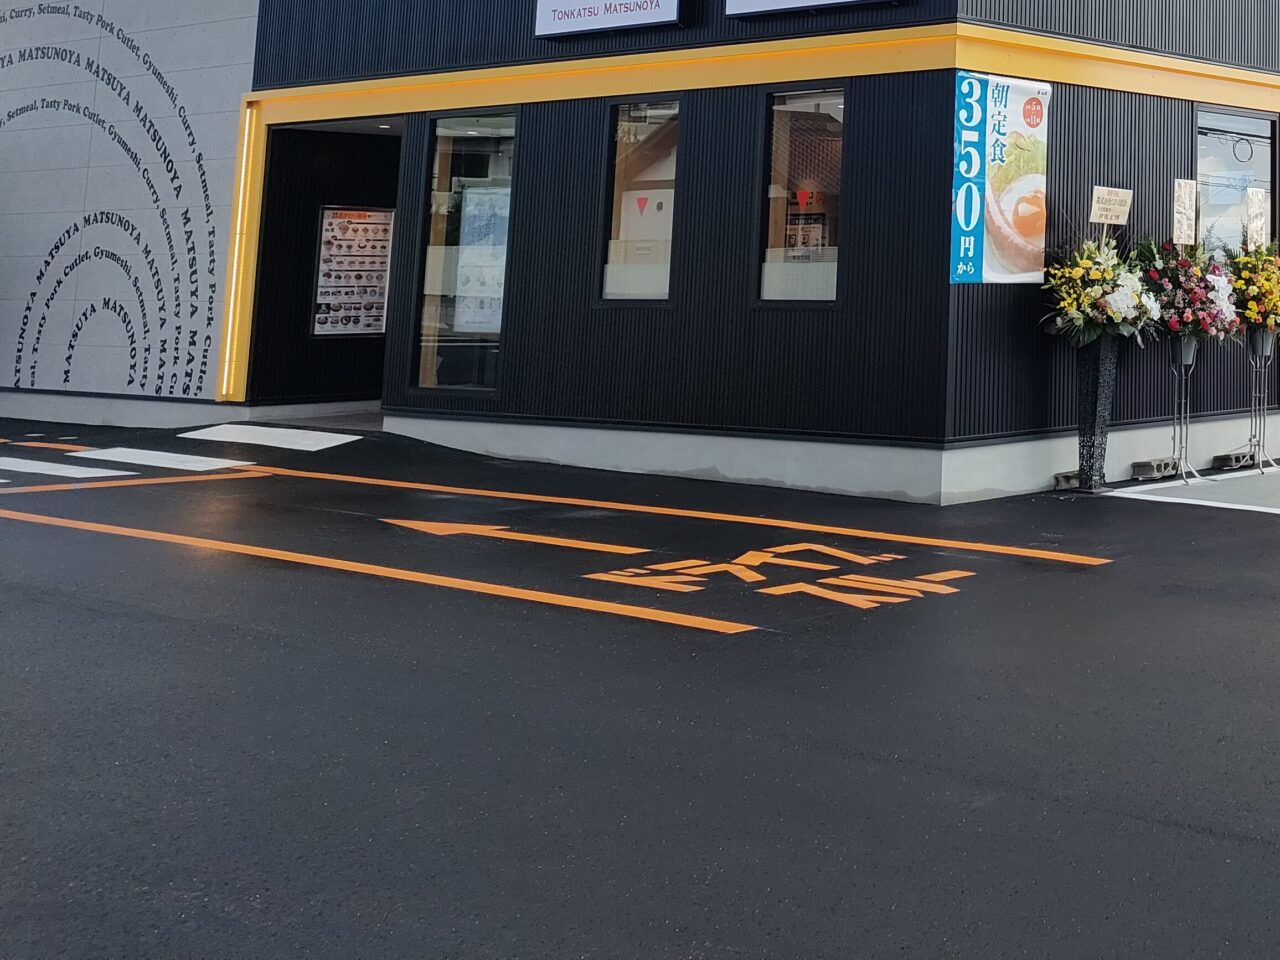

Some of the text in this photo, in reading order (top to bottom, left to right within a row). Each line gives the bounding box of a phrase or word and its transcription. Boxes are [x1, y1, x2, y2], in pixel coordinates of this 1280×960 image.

[9, 8, 35, 20] Curry,
[37, 3, 71, 19] Setmeal,
[73, 5, 95, 25] Tasty
[95, 13, 115, 35] Pork
[116, 28, 141, 61] Cutlet,
[40, 98, 61, 111] Tasty
[142, 52, 178, 110] Gyumeshi,
[62, 99, 81, 115] Pork
[82, 106, 106, 133] Cutlet,
[178, 105, 197, 154] Curry,
[990, 82, 1010, 164] 朝定食
[108, 124, 142, 173] Gyumeshi,
[18, 46, 81, 68] MATSUNOYA
[84, 56, 131, 107] MATSUYA
[133, 100, 182, 201] MATSUNOYA
[180, 207, 199, 320] MATSUYA
[142, 168, 160, 210] Curry,
[195, 152, 214, 224] Setmeal,
[956, 78, 982, 276] 350円から
[159, 207, 178, 272] Setmeal,
[207, 225, 216, 277] Tasty
[36, 222, 80, 286] MATSUYA
[82, 211, 141, 247] MATSUNOYA
[142, 242, 167, 330] MATSUYA
[31, 311, 47, 356] Tasty
[44, 277, 63, 311] Pork
[63, 250, 92, 278] Cutlet,
[93, 246, 132, 281] Gyumeshi,
[140, 343, 151, 391] Tasty
[172, 272, 181, 320] Tasty
[205, 282, 217, 329] Pork
[62, 296, 137, 387] MATSUYA MATSUNOYA
[171, 325, 182, 366] Pork
